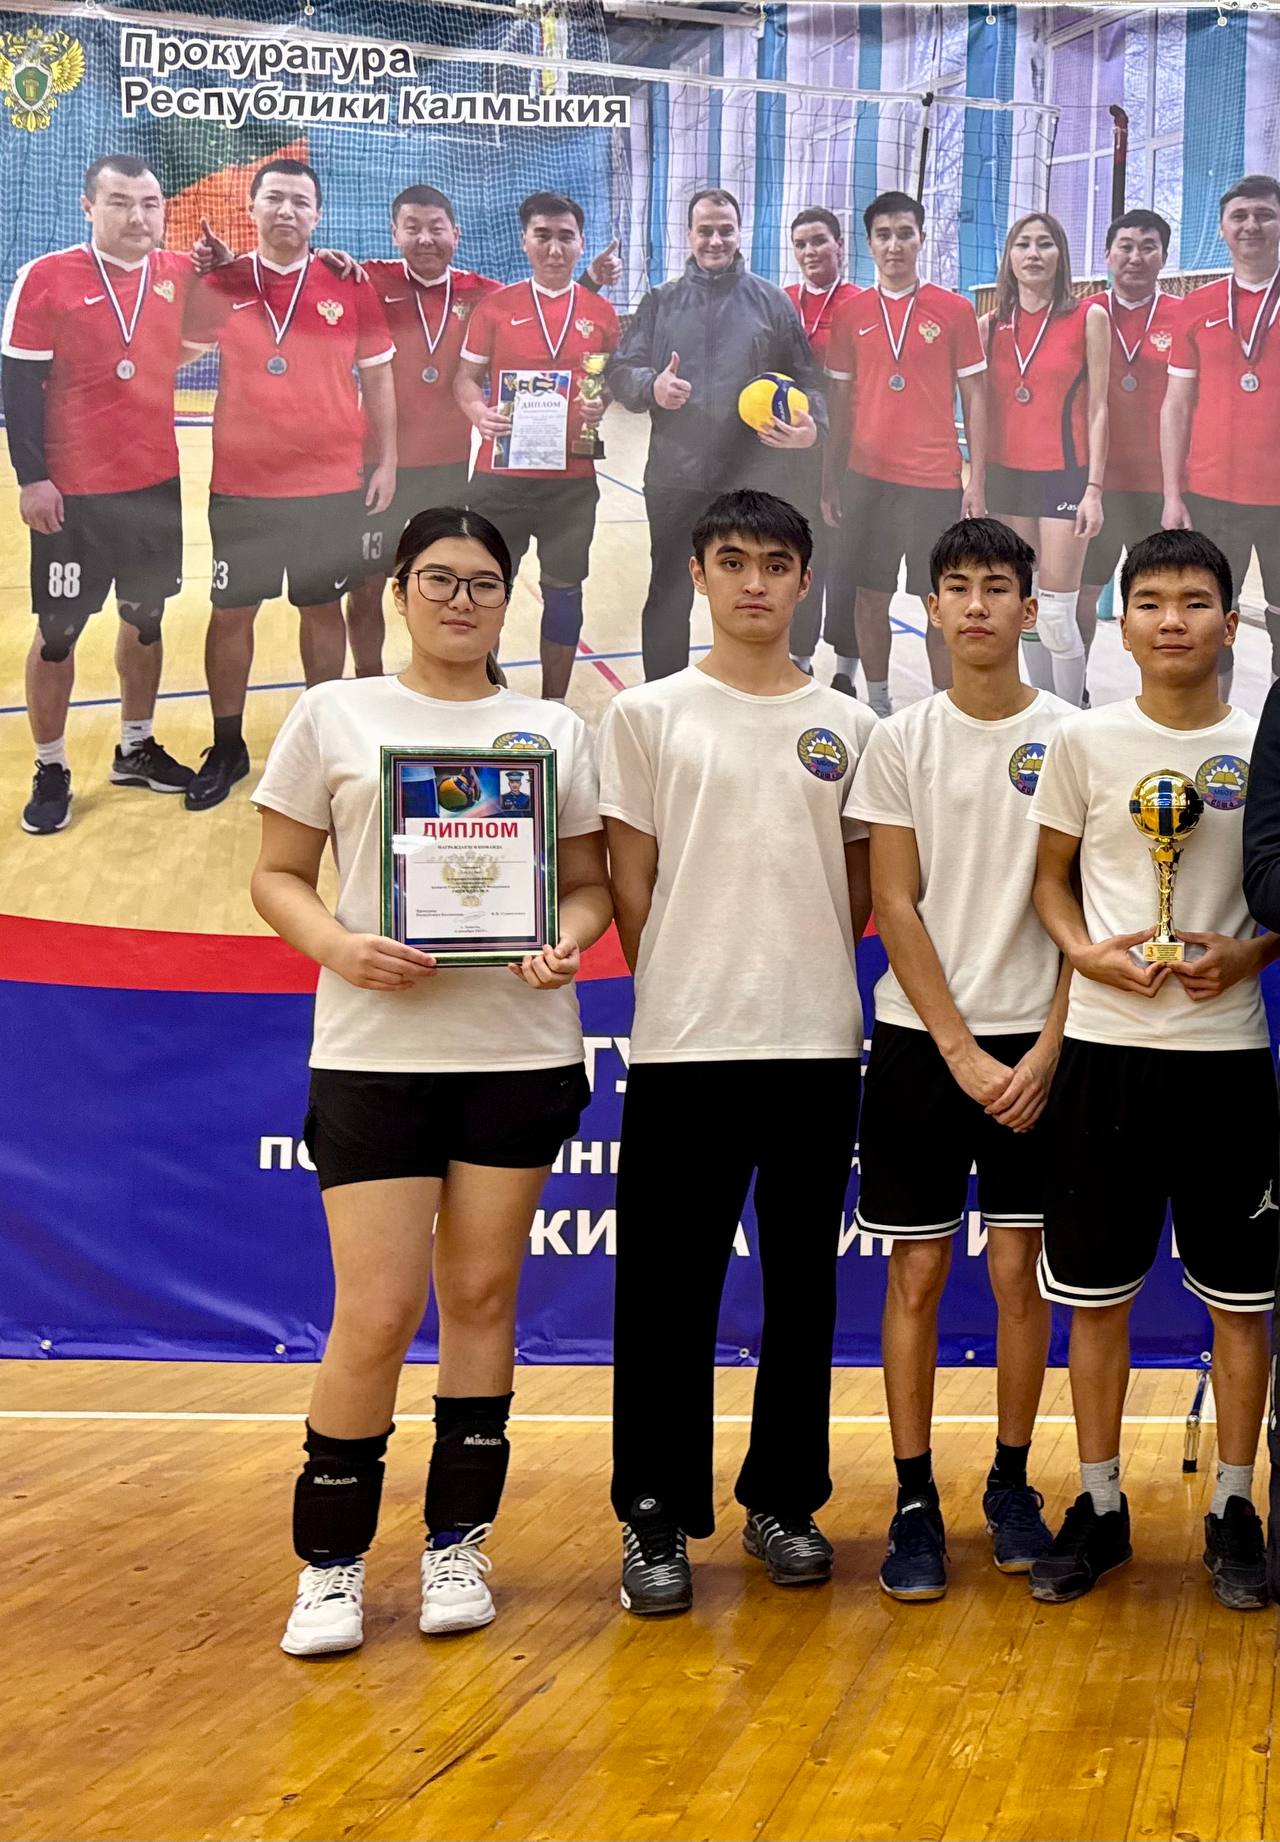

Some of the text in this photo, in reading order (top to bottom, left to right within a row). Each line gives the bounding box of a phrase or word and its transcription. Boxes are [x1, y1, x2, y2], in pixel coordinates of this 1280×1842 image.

[122, 31, 413, 78] Прокуратура
[123, 80, 629, 126] Республики Калмыкия
[48, 562, 81, 598] 88
[423, 821, 518, 840] ДИПЛОМ
